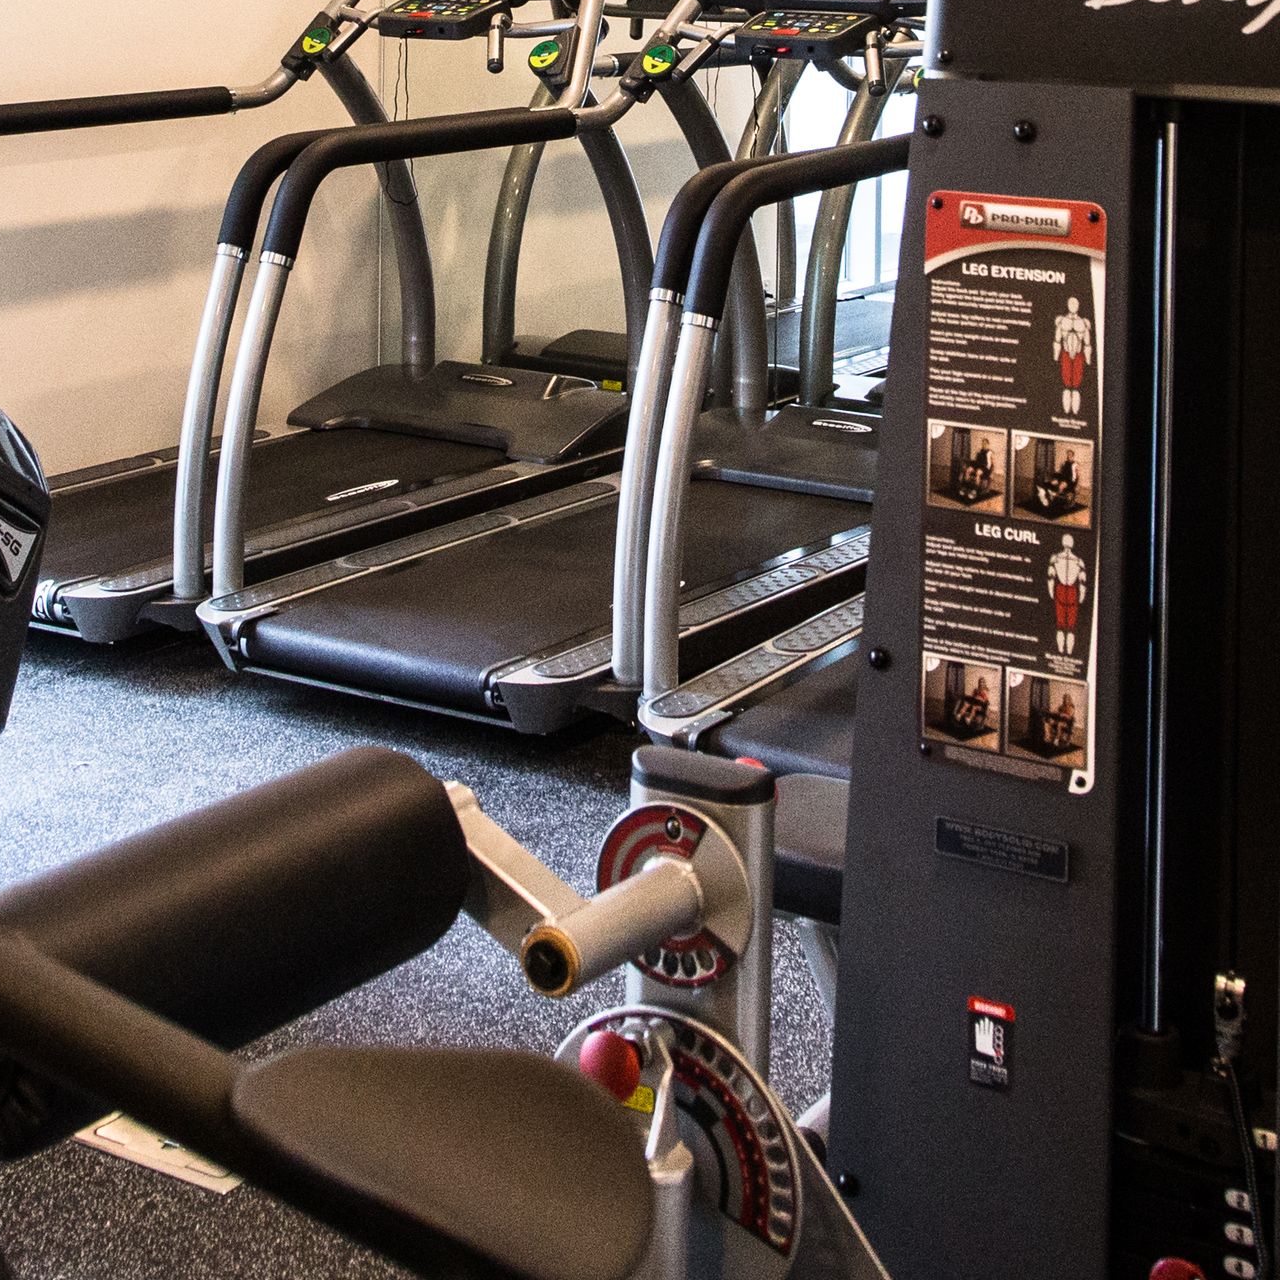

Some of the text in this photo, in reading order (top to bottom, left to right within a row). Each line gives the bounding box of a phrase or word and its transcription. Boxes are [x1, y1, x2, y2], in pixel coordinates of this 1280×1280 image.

[962, 263, 1066, 284] LEG EXTENSION
[974, 523, 1040, 545] LEG CURL
